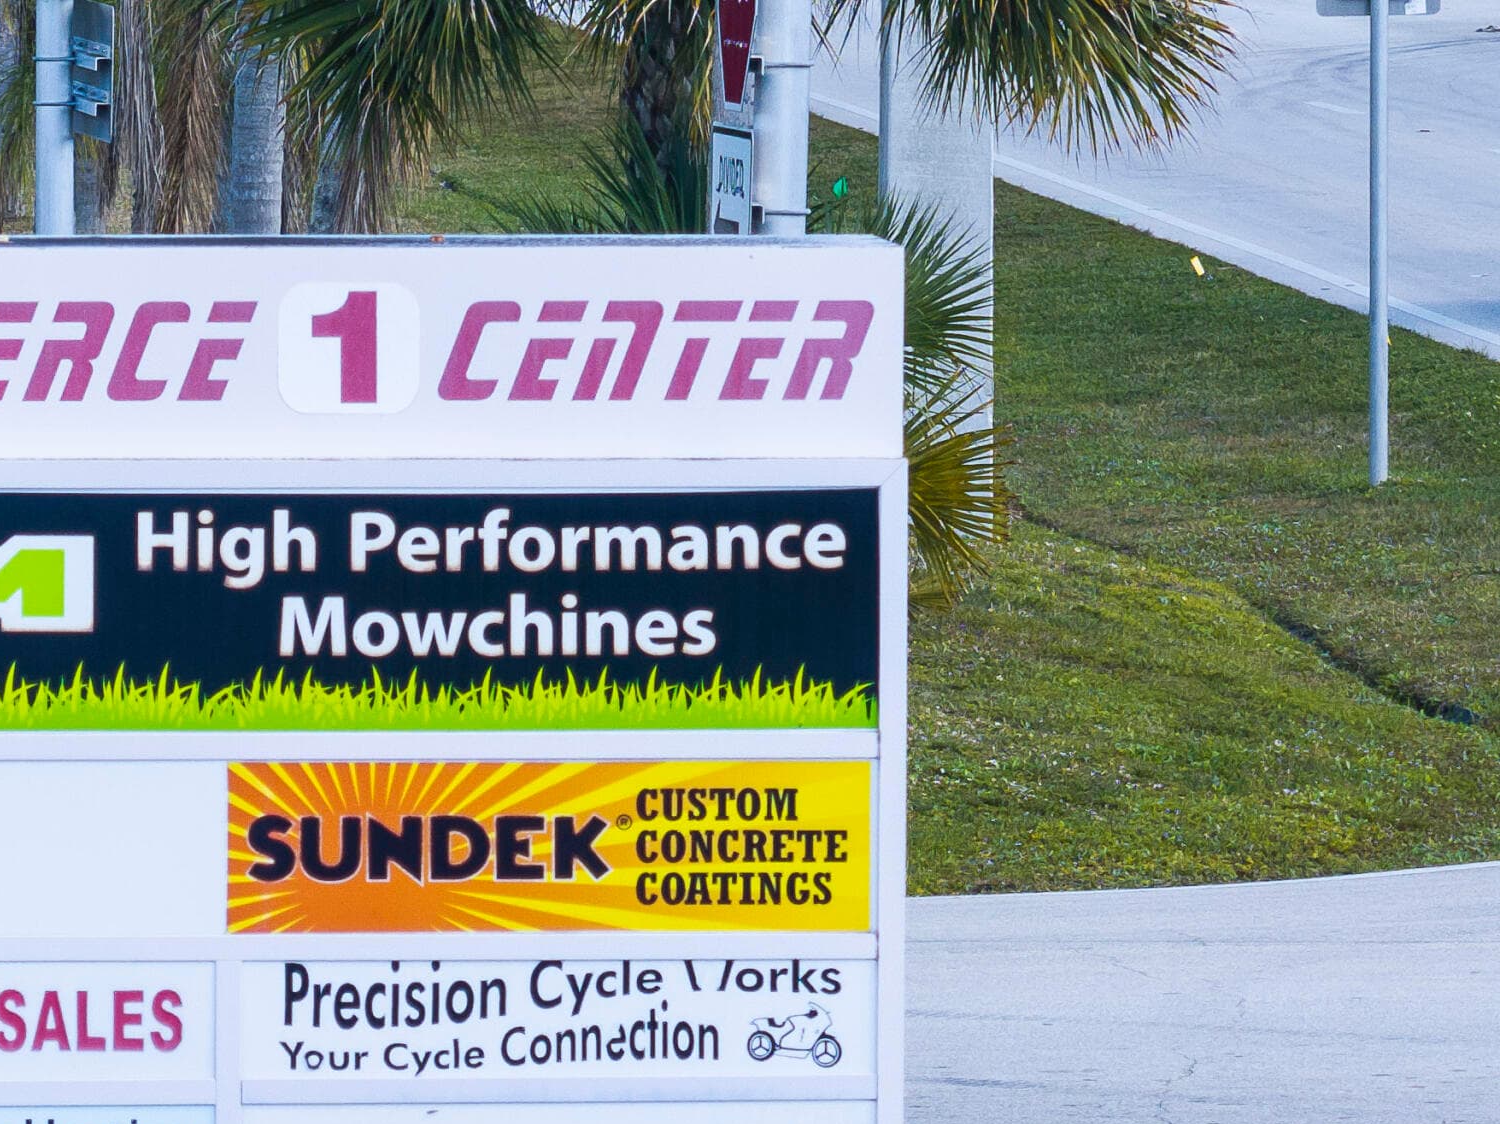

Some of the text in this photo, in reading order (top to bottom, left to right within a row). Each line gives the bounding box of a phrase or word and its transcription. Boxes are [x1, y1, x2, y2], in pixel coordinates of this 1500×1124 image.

[311, 290, 378, 404] 1
[437, 300, 875, 401] CENTER
[137, 507, 847, 589] High Performance
[279, 593, 717, 658] Mowchines
[635, 787, 799, 822] CUSTOM
[635, 829, 849, 864] CONCRETE
[635, 872, 833, 906] COATINGS
[283, 960, 508, 1029] Precision
[528, 960, 664, 1016] Cycle
[279, 999, 720, 1077] Your Cycle Connection
